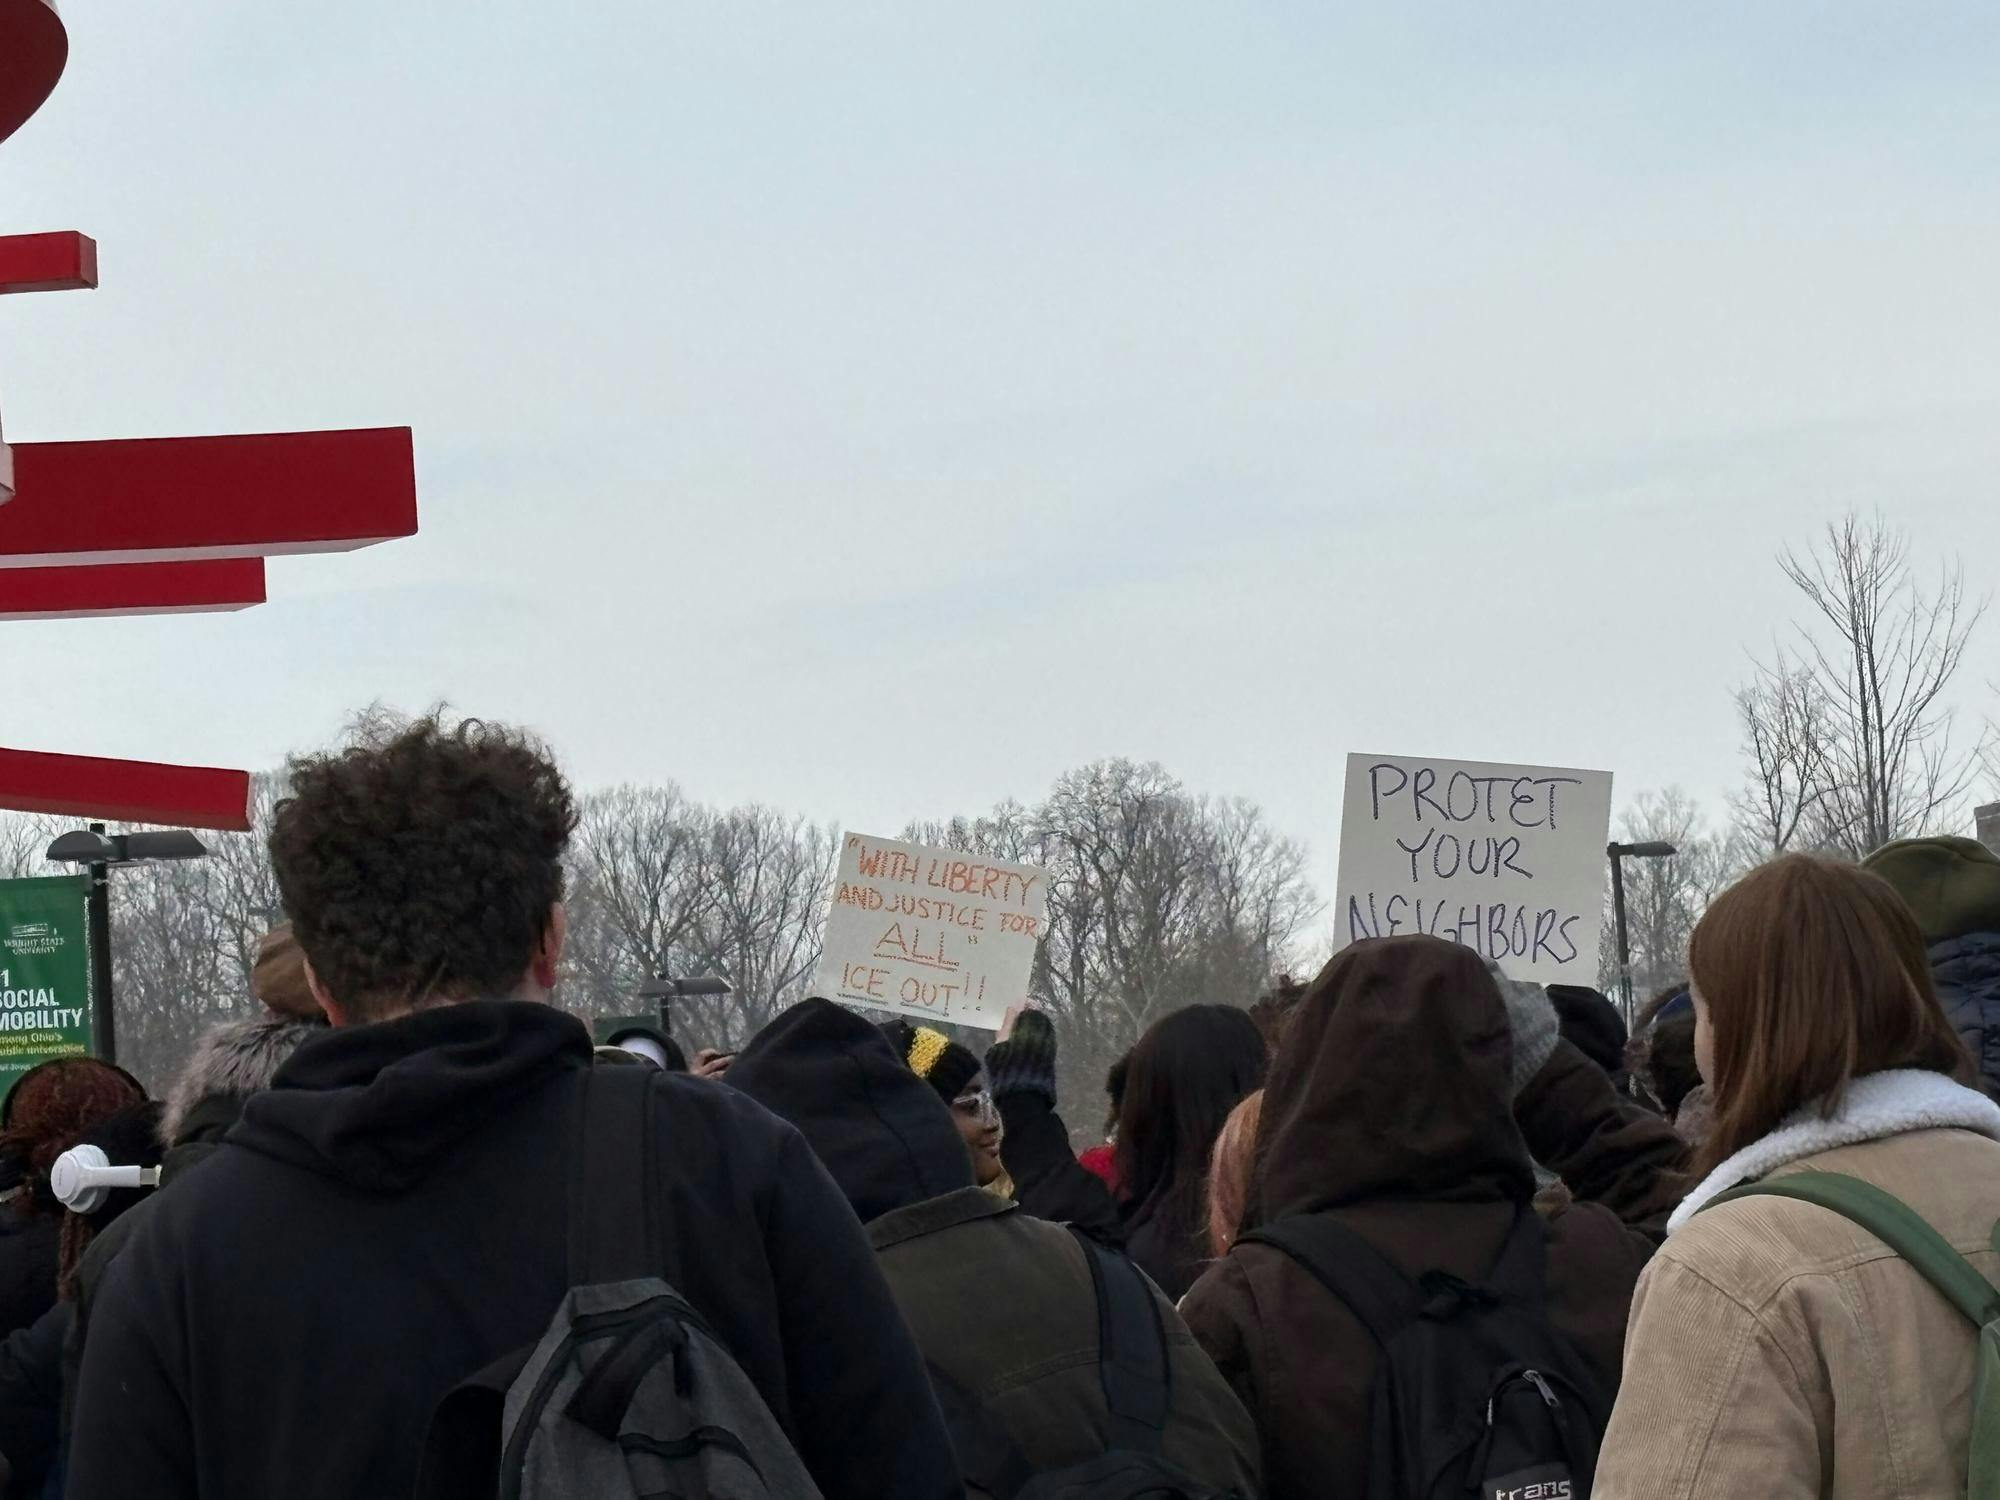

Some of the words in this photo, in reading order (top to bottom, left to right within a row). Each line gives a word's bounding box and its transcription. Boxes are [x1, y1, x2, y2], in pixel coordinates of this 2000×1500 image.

[1369, 764, 1582, 830] PROTET
[1396, 827, 1533, 882] YOUR
[927, 858, 1038, 906] LIBERTY
[0, 987, 60, 1009] OCIAL
[842, 962, 892, 998] ICE
